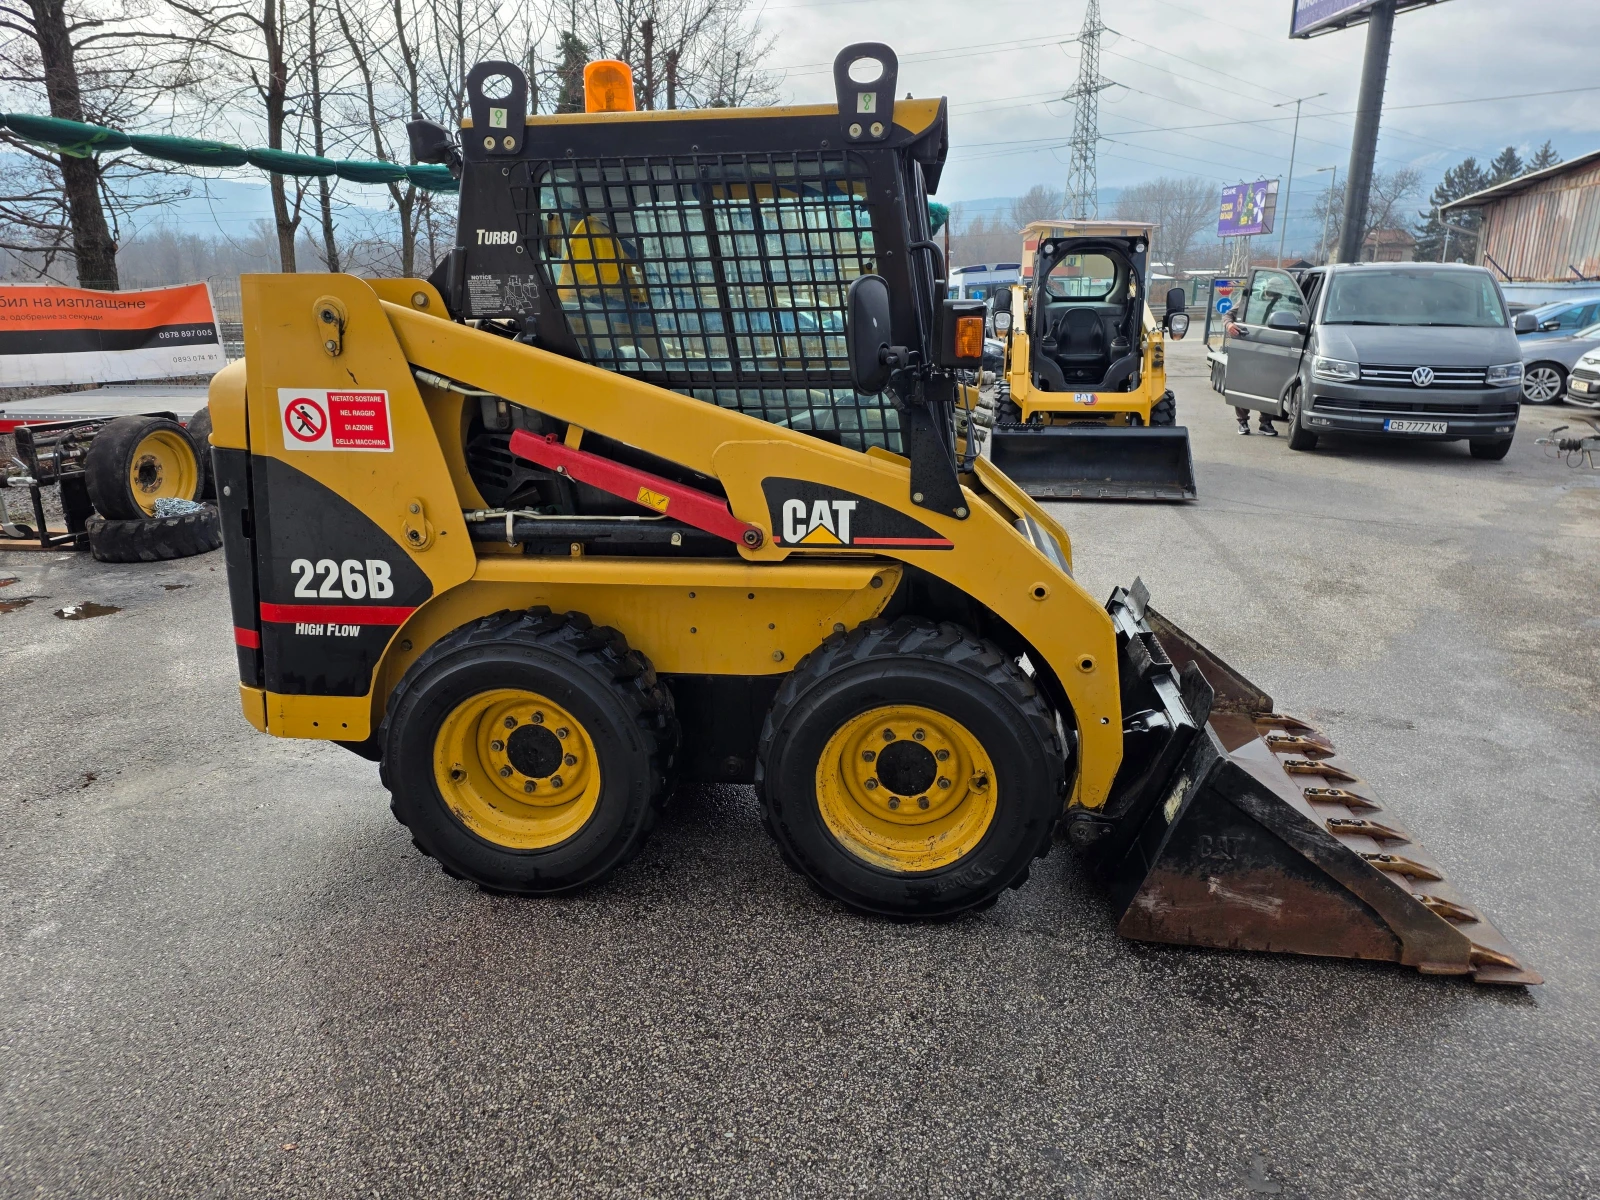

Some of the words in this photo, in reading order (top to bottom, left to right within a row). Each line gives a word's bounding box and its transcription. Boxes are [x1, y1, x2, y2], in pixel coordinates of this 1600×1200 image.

[476, 229, 518, 245] TURBO
[33, 298, 52, 308] на
[56, 299, 146, 311] изплащане
[158, 331, 180, 339] 0878
[181, 330, 195, 338] 897
[196, 329, 213, 337] 005
[172, 355, 192, 363] 0893
[1074, 393, 1092, 403] CAT
[1390, 421, 1404, 431] CB
[1405, 422, 1431, 432] 7777
[1431, 423, 1446, 433] KK
[782, 498, 857, 545] CAT
[290, 558, 394, 600] 226B
[295, 622, 324, 636] HIGH
[326, 623, 360, 637] FLOW
